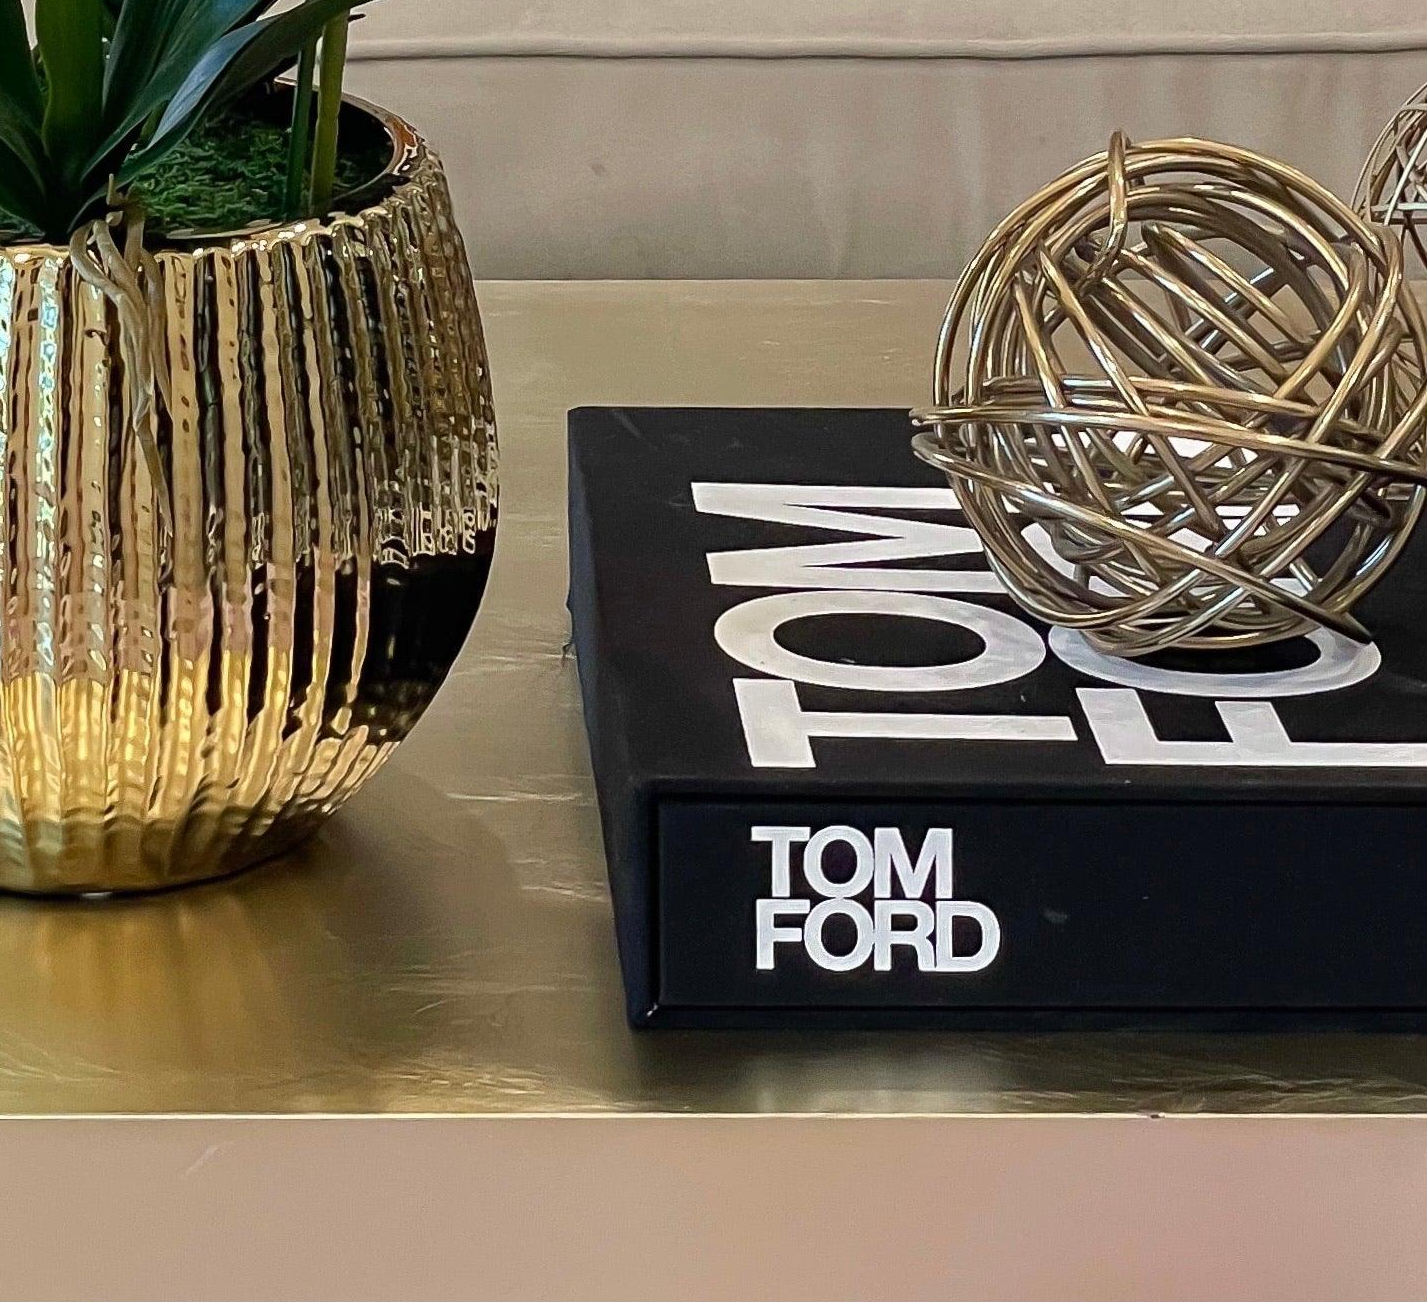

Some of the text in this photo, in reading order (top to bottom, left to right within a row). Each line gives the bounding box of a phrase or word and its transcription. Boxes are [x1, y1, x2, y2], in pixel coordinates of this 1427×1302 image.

[691, 481, 1078, 769] TOM
[750, 824, 954, 900] TOM
[755, 896, 1001, 973] FORD
